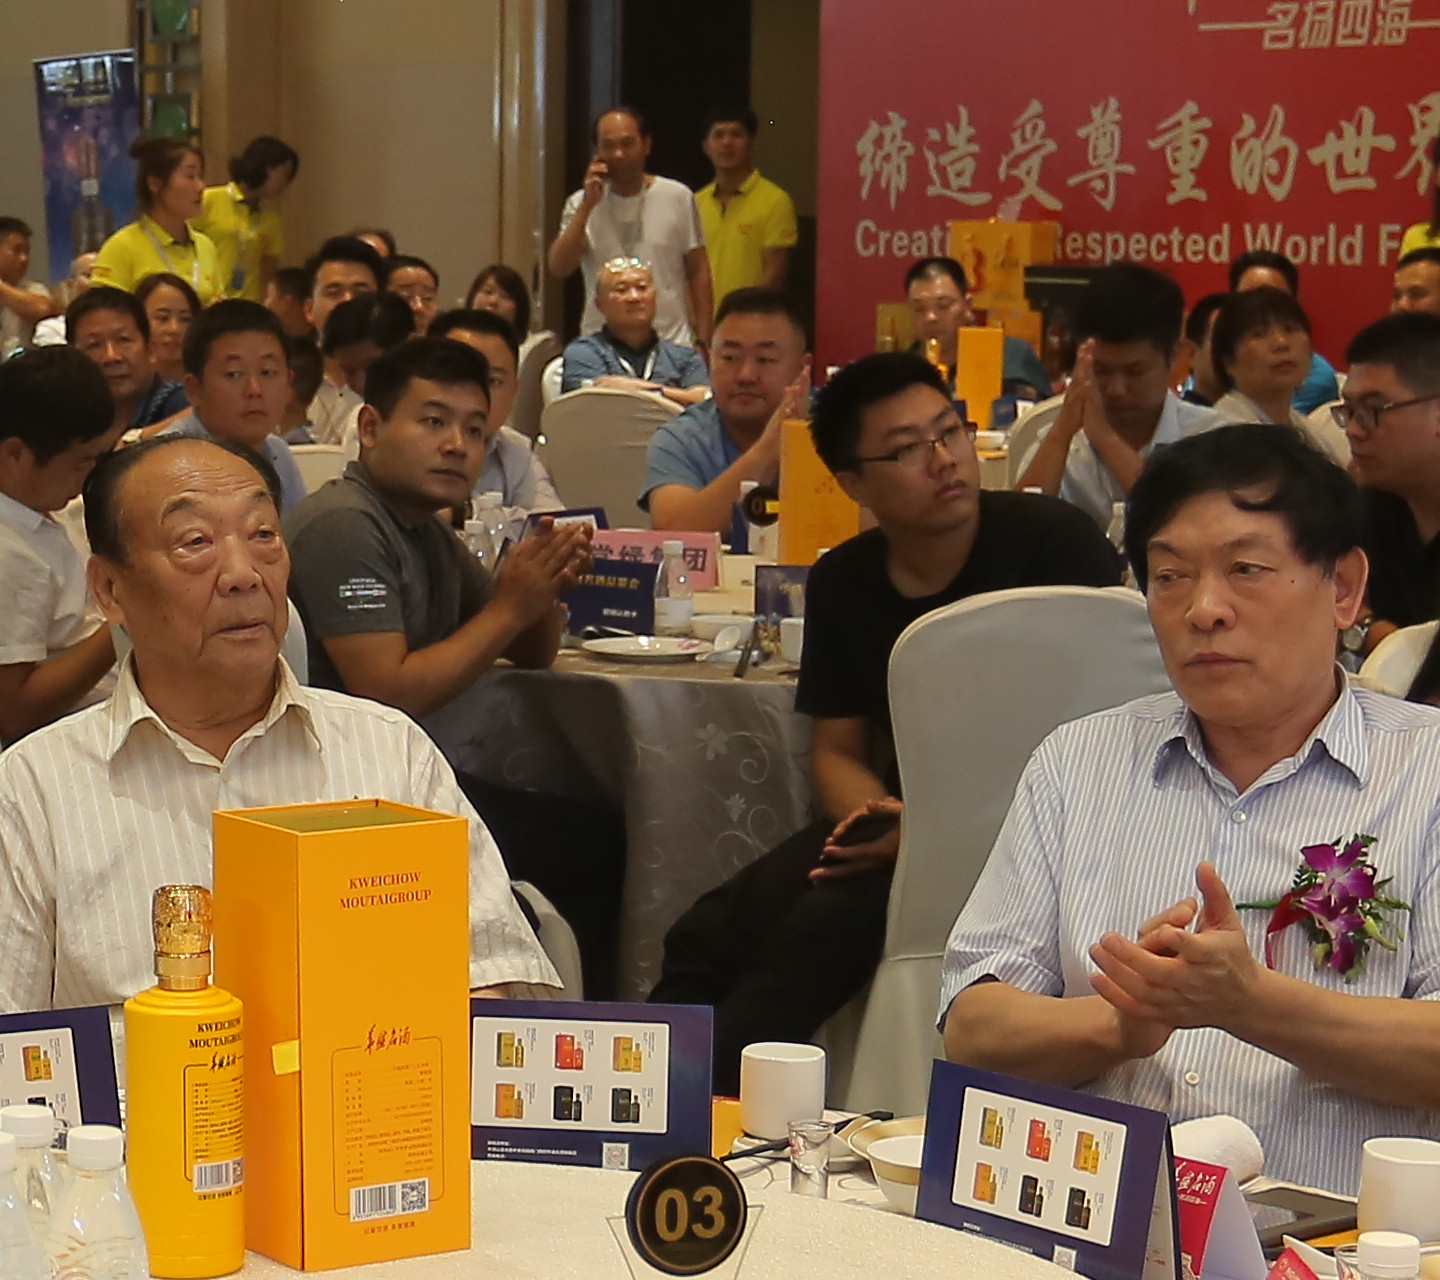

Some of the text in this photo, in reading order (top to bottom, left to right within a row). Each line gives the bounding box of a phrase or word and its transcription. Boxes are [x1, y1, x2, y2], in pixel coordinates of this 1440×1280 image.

[1242, 223, 1363, 266] World
[348, 871, 422, 890] KWEICHOW
[339, 888, 432, 910] MOUTAIGROUP
[654, 1185, 727, 1242] 03
